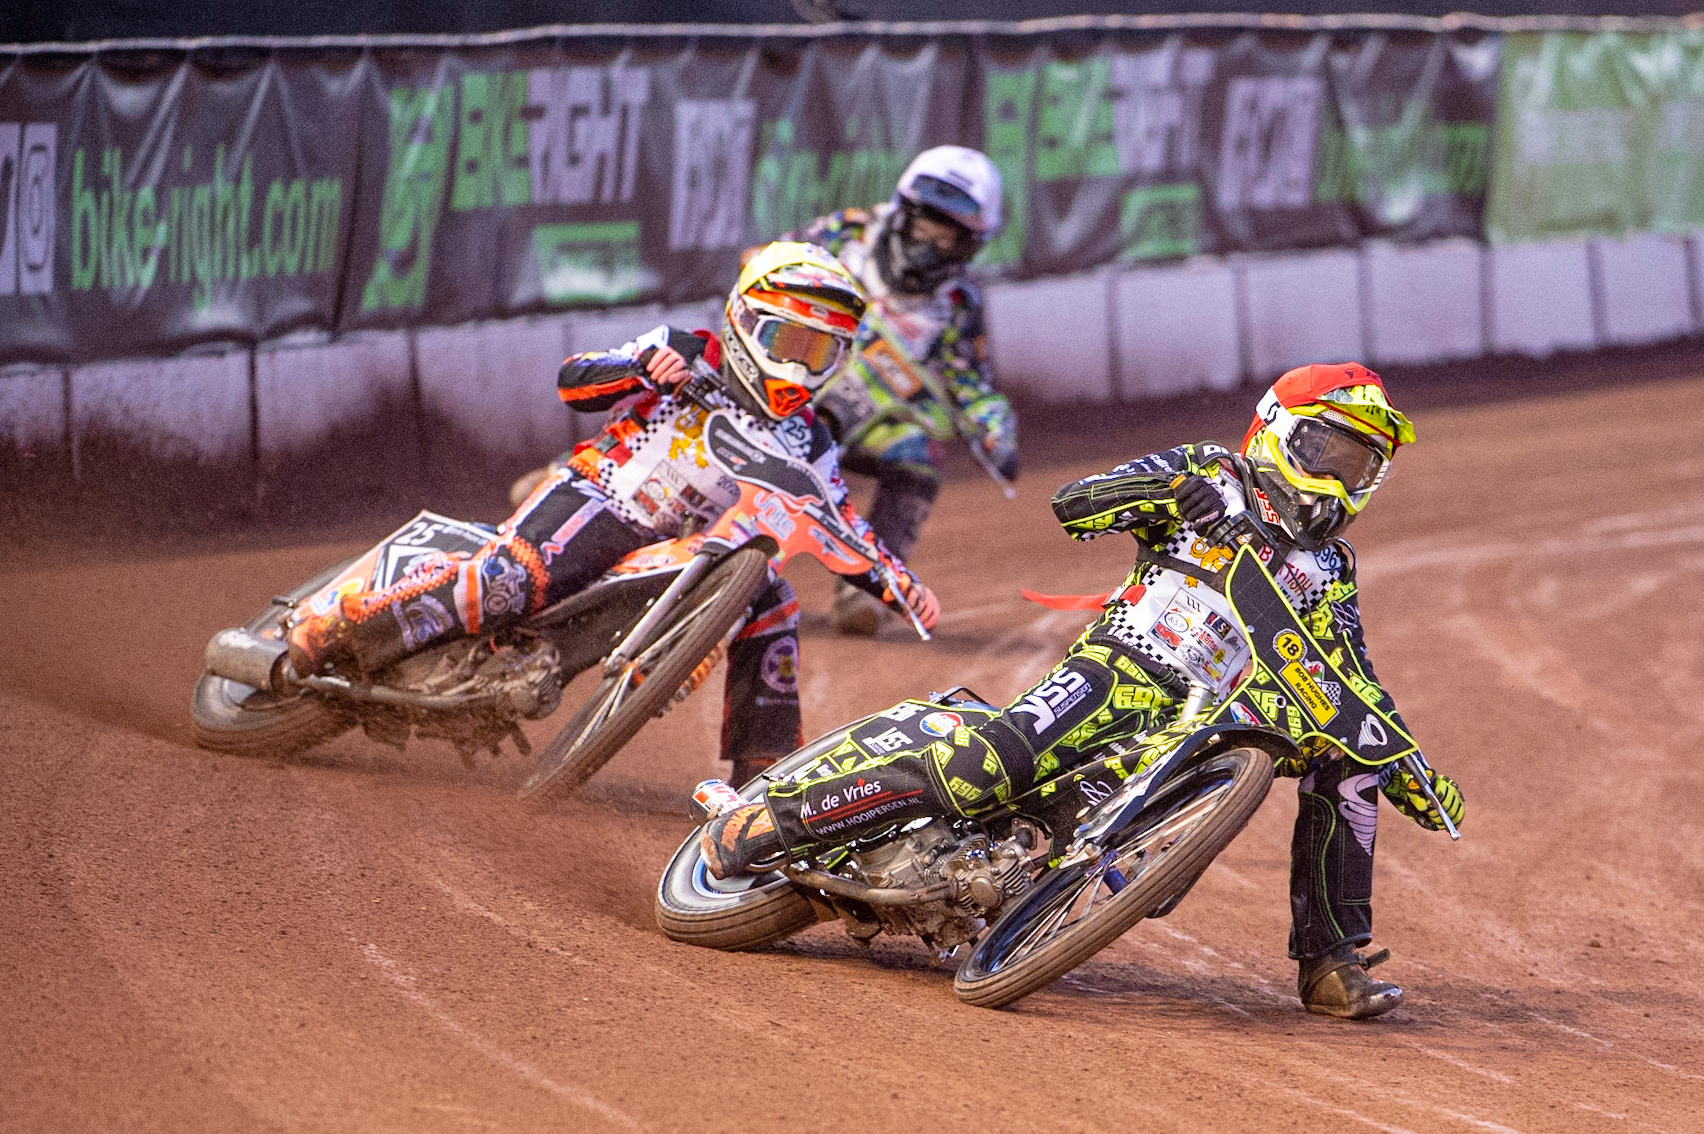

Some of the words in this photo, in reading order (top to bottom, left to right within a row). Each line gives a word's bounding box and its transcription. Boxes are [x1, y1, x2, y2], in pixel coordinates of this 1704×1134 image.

[72, 146, 342, 310] bike-right.com
[785, 421, 806, 440] 25
[394, 522, 442, 546] 25
[1281, 636, 1299, 656] 18
[1010, 667, 1087, 735] YSS
[1295, 667, 1310, 684] BOB
[1307, 683, 1331, 711] HUGHES
[1295, 682, 1317, 709] RACING
[800, 802, 817, 818] M.
[821, 795, 840, 812] de
[843, 777, 882, 802] Vries
